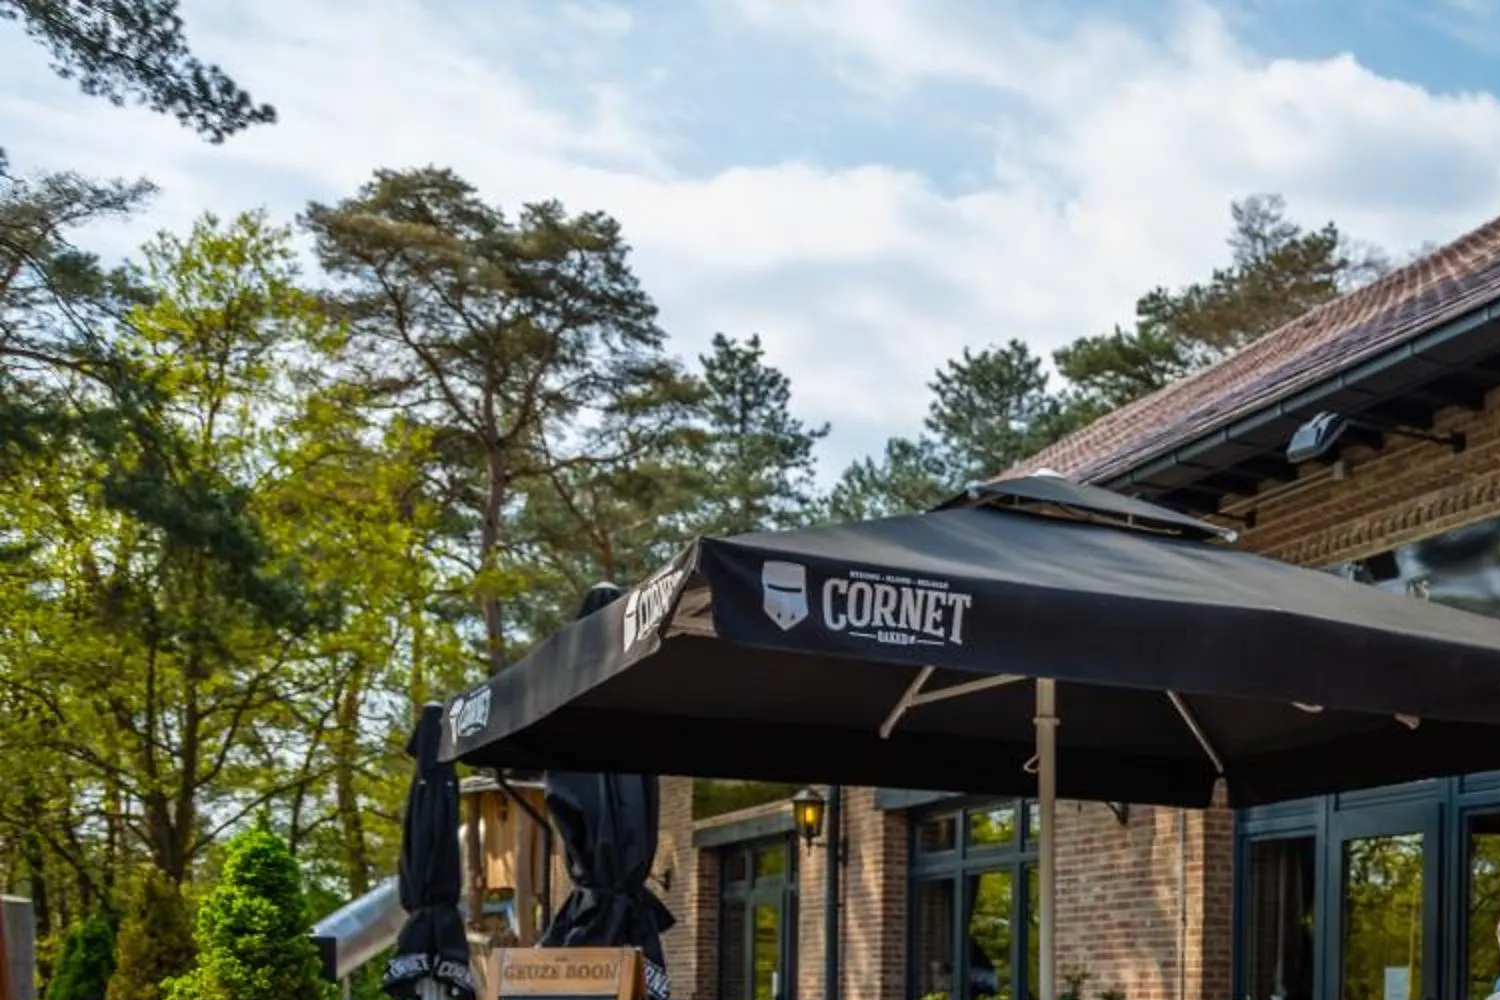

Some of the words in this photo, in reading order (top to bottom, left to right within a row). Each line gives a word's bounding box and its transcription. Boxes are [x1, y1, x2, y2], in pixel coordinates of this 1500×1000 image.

[822, 577, 972, 645] CORNET
[503, 963, 558, 980] GEUZE
[565, 962, 618, 980] BOON
